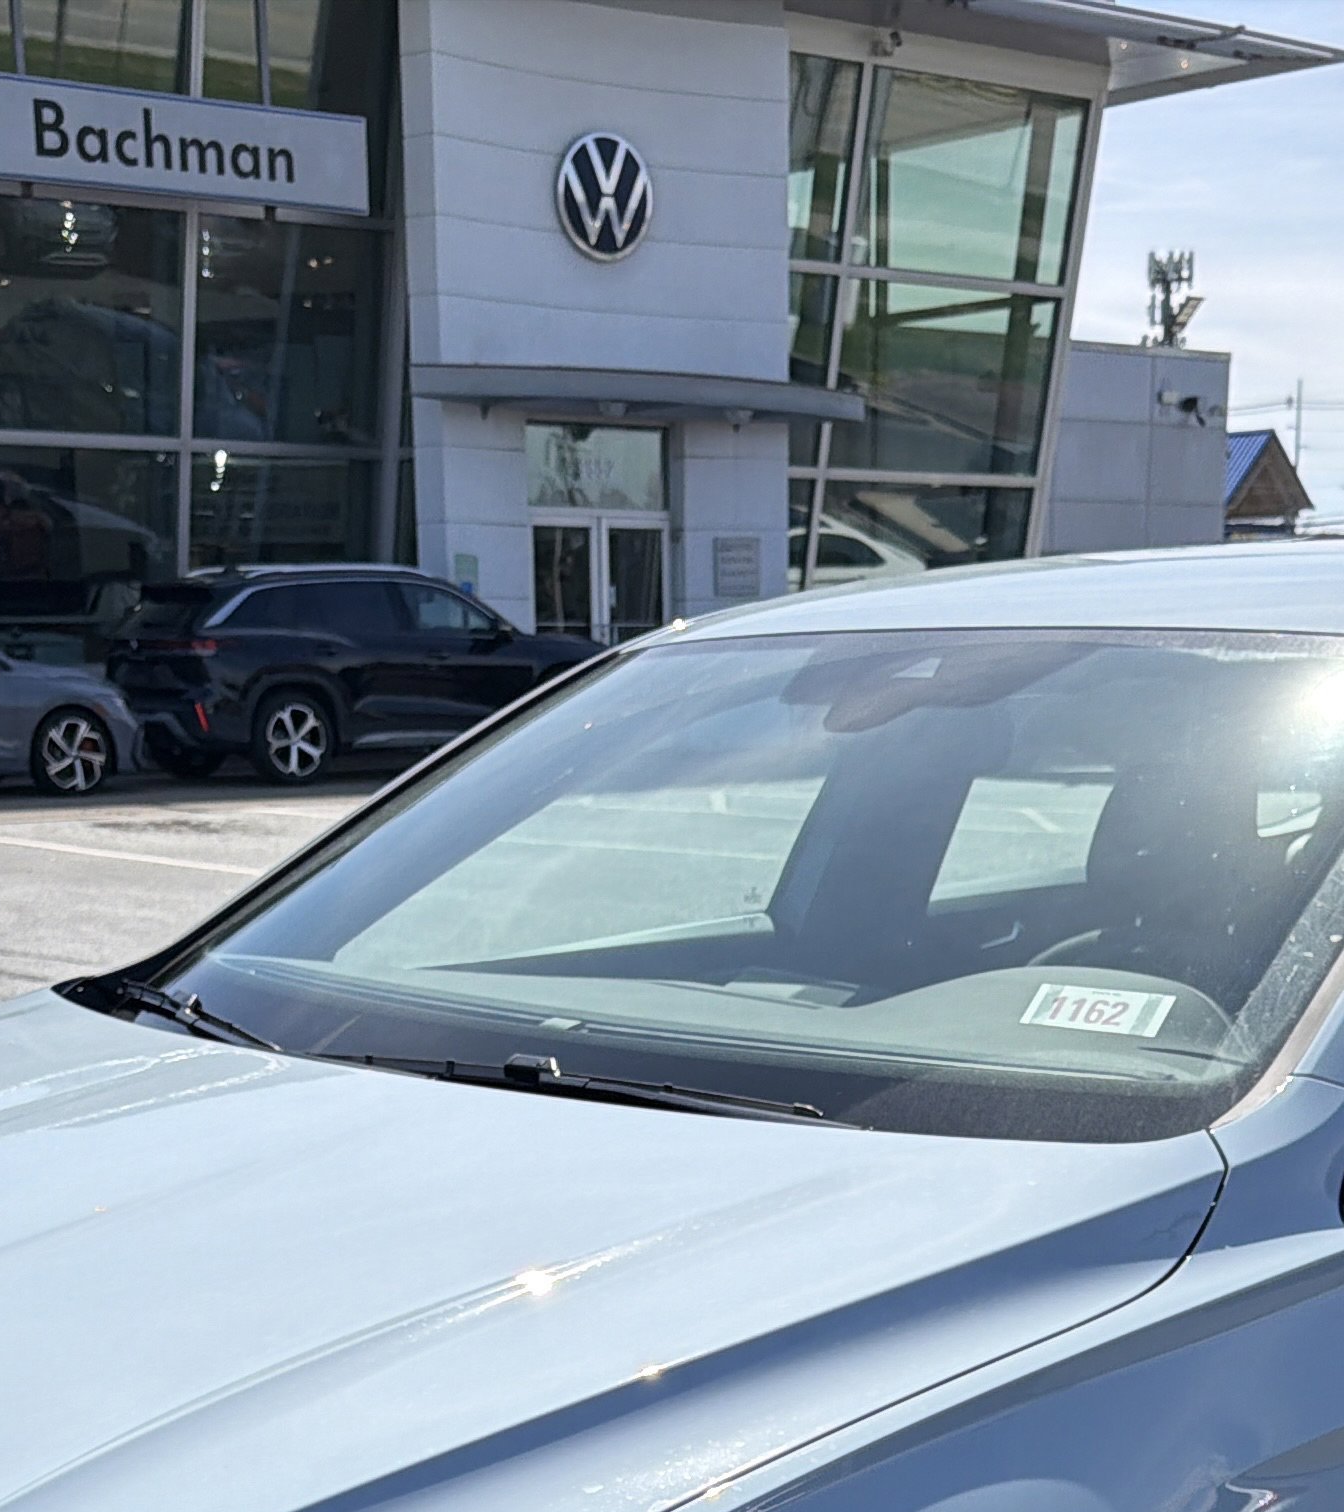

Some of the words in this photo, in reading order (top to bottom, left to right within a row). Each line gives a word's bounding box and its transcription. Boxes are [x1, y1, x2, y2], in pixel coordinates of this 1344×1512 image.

[33, 99, 295, 184] Bachman
[560, 135, 650, 256] VW
[1048, 996, 1130, 1027] 1162
